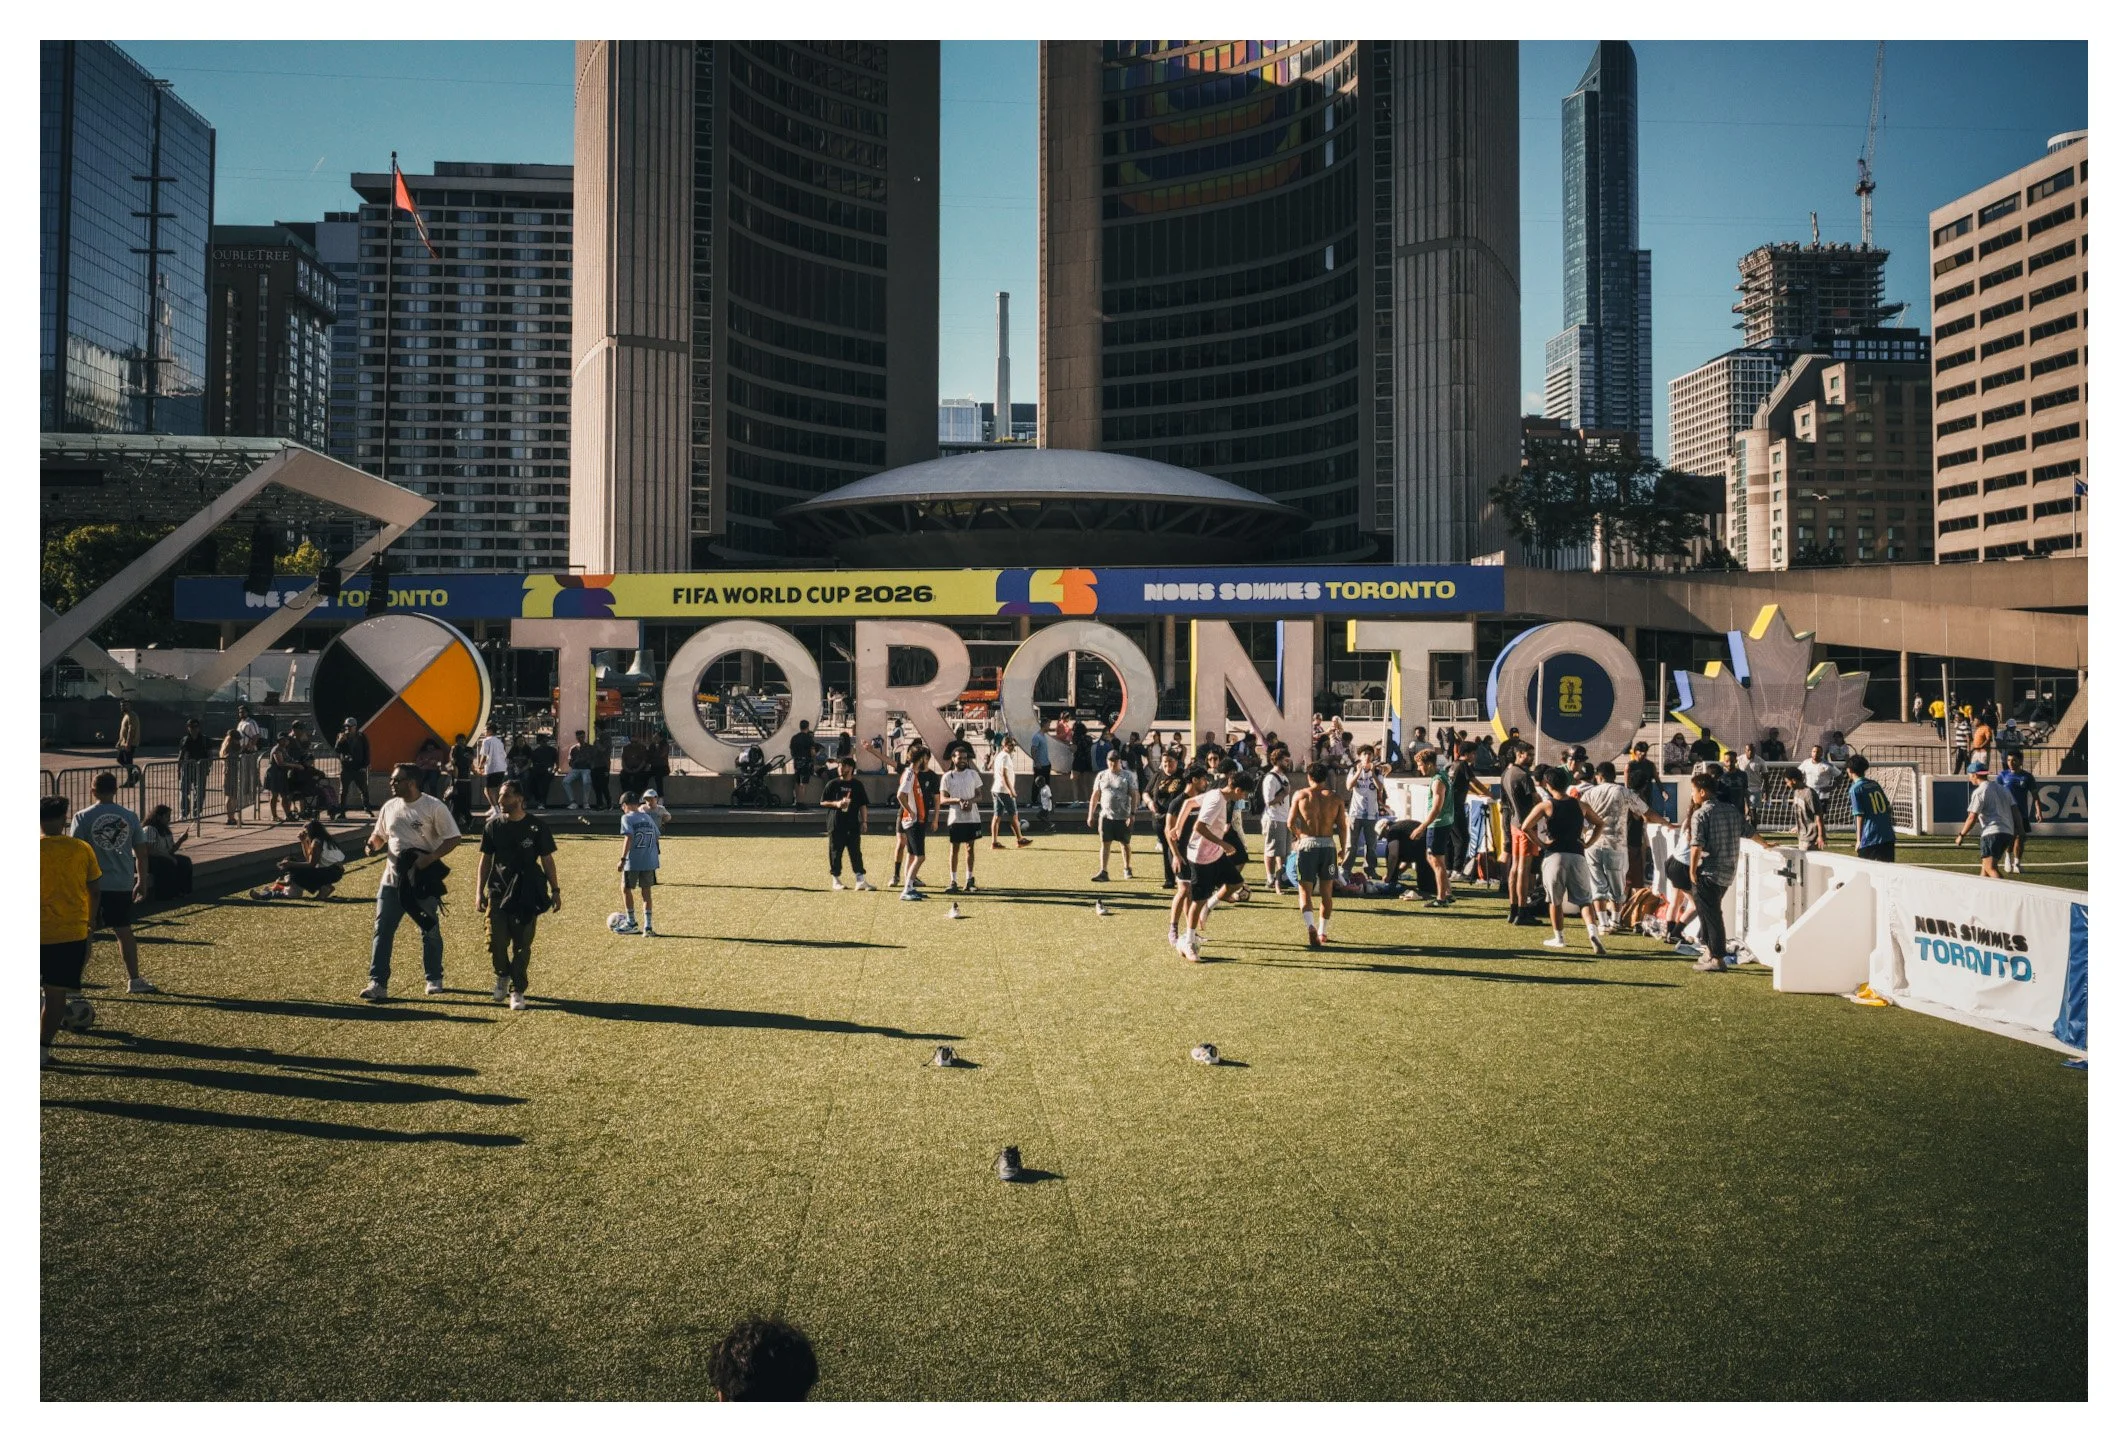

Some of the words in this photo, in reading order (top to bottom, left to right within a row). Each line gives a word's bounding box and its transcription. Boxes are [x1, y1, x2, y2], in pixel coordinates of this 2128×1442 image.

[212, 249, 290, 261] OUBLETREE
[337, 589, 449, 607] TOONTO
[673, 588, 719, 604] FIFA
[723, 587, 802, 604] WORLD
[807, 587, 850, 603] CUP
[855, 586, 933, 602] 2026
[1144, 583, 1215, 601] NOUS
[1219, 582, 1321, 600] SOMMES
[1325, 581, 1456, 599] TORONTO
[511, 619, 1645, 775] TORONTO
[1868, 790, 1886, 815] 10
[2032, 785, 2088, 819] SA
[635, 831, 655, 849] 27
[1915, 915, 1958, 938] NOUS
[1914, 936, 2032, 982] TORONTO
